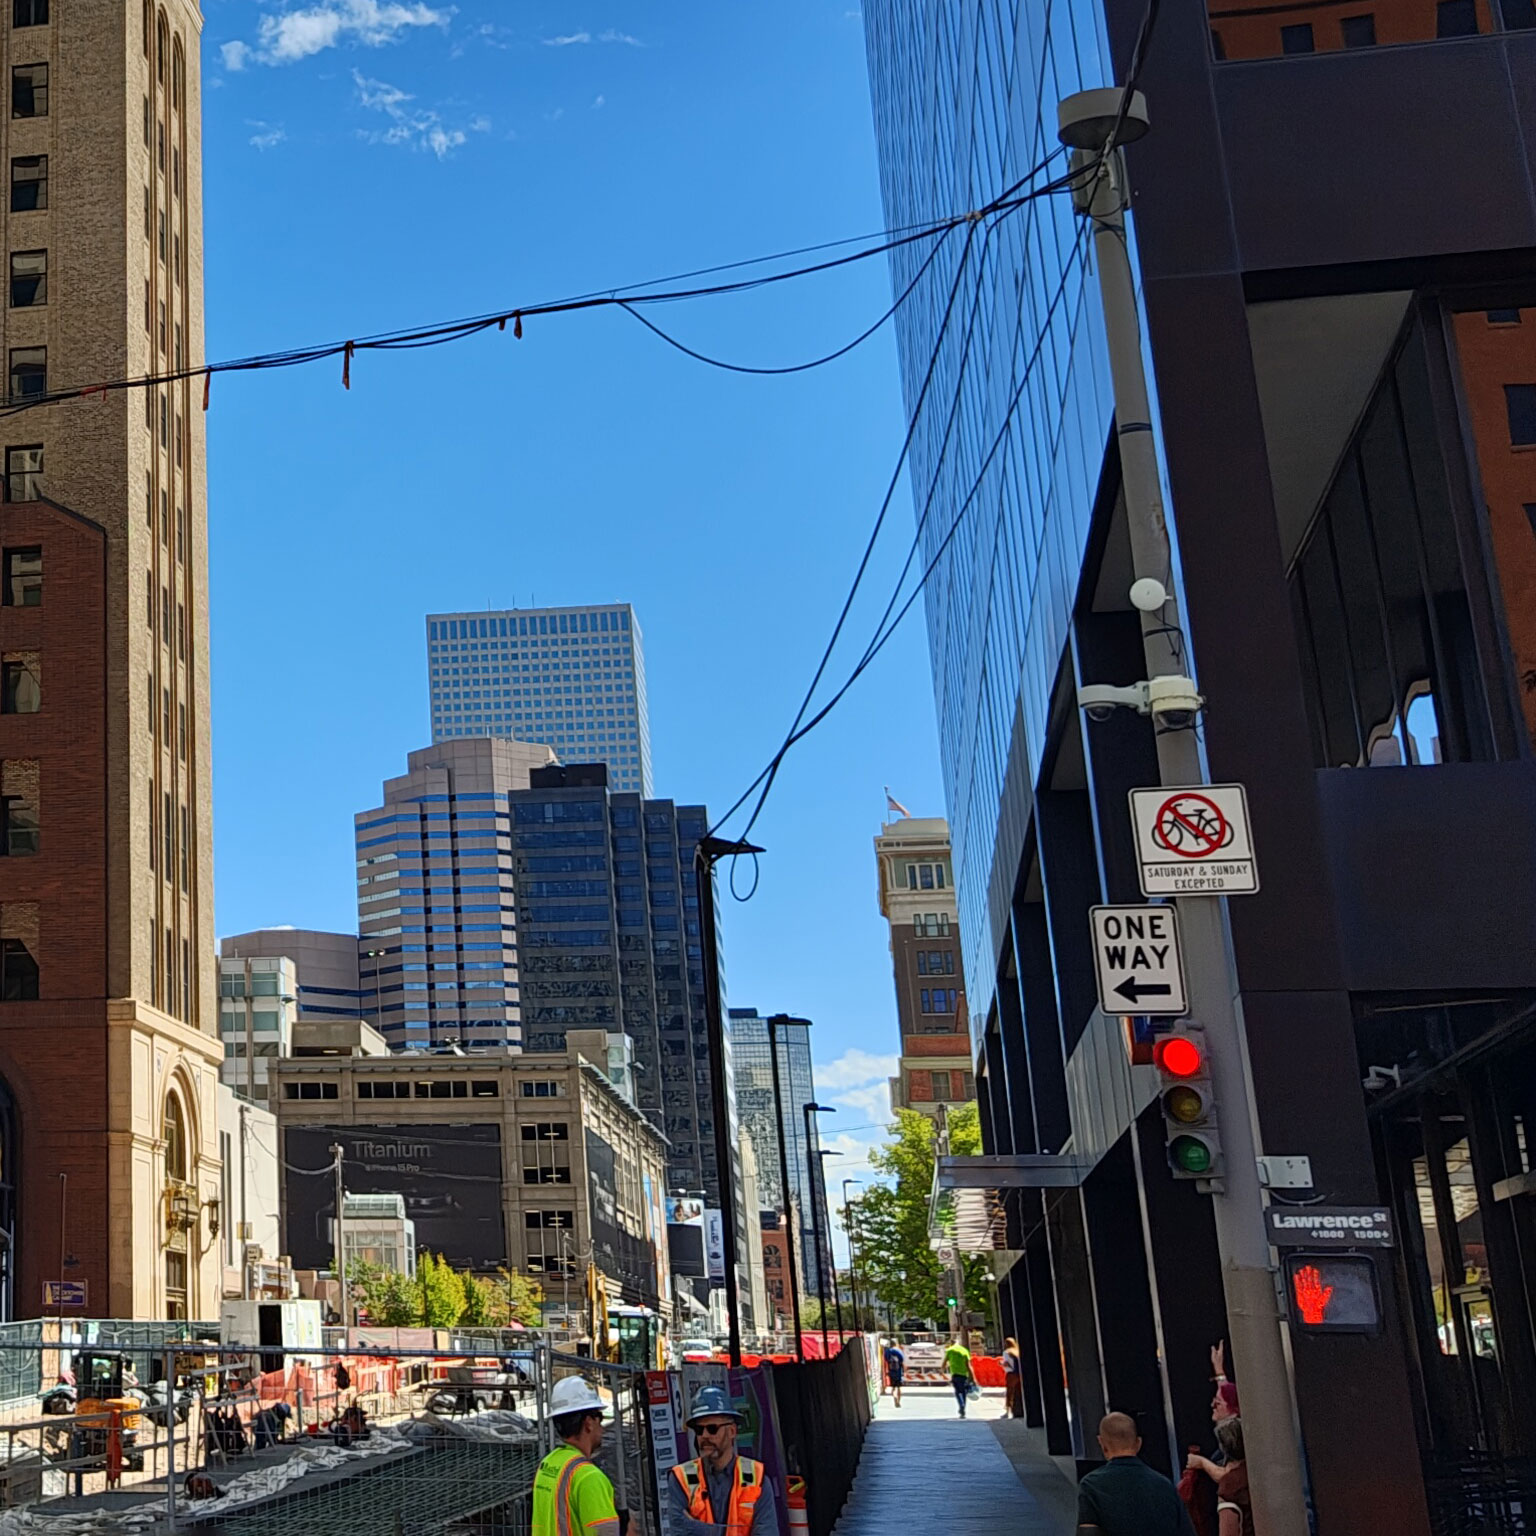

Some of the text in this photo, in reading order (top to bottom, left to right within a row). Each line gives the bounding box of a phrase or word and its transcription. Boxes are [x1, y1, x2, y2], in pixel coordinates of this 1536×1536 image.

[1147, 865, 1248, 878] SATURDAY & SUNDAY
[1174, 878, 1225, 889] EXCEPTED
[1104, 915, 1167, 940] ONE
[1104, 945, 1170, 970] WAY
[351, 1140, 431, 1158] Titanium
[406, 1164, 420, 1172] Pro
[1272, 1212, 1387, 1228] Lawrence St
